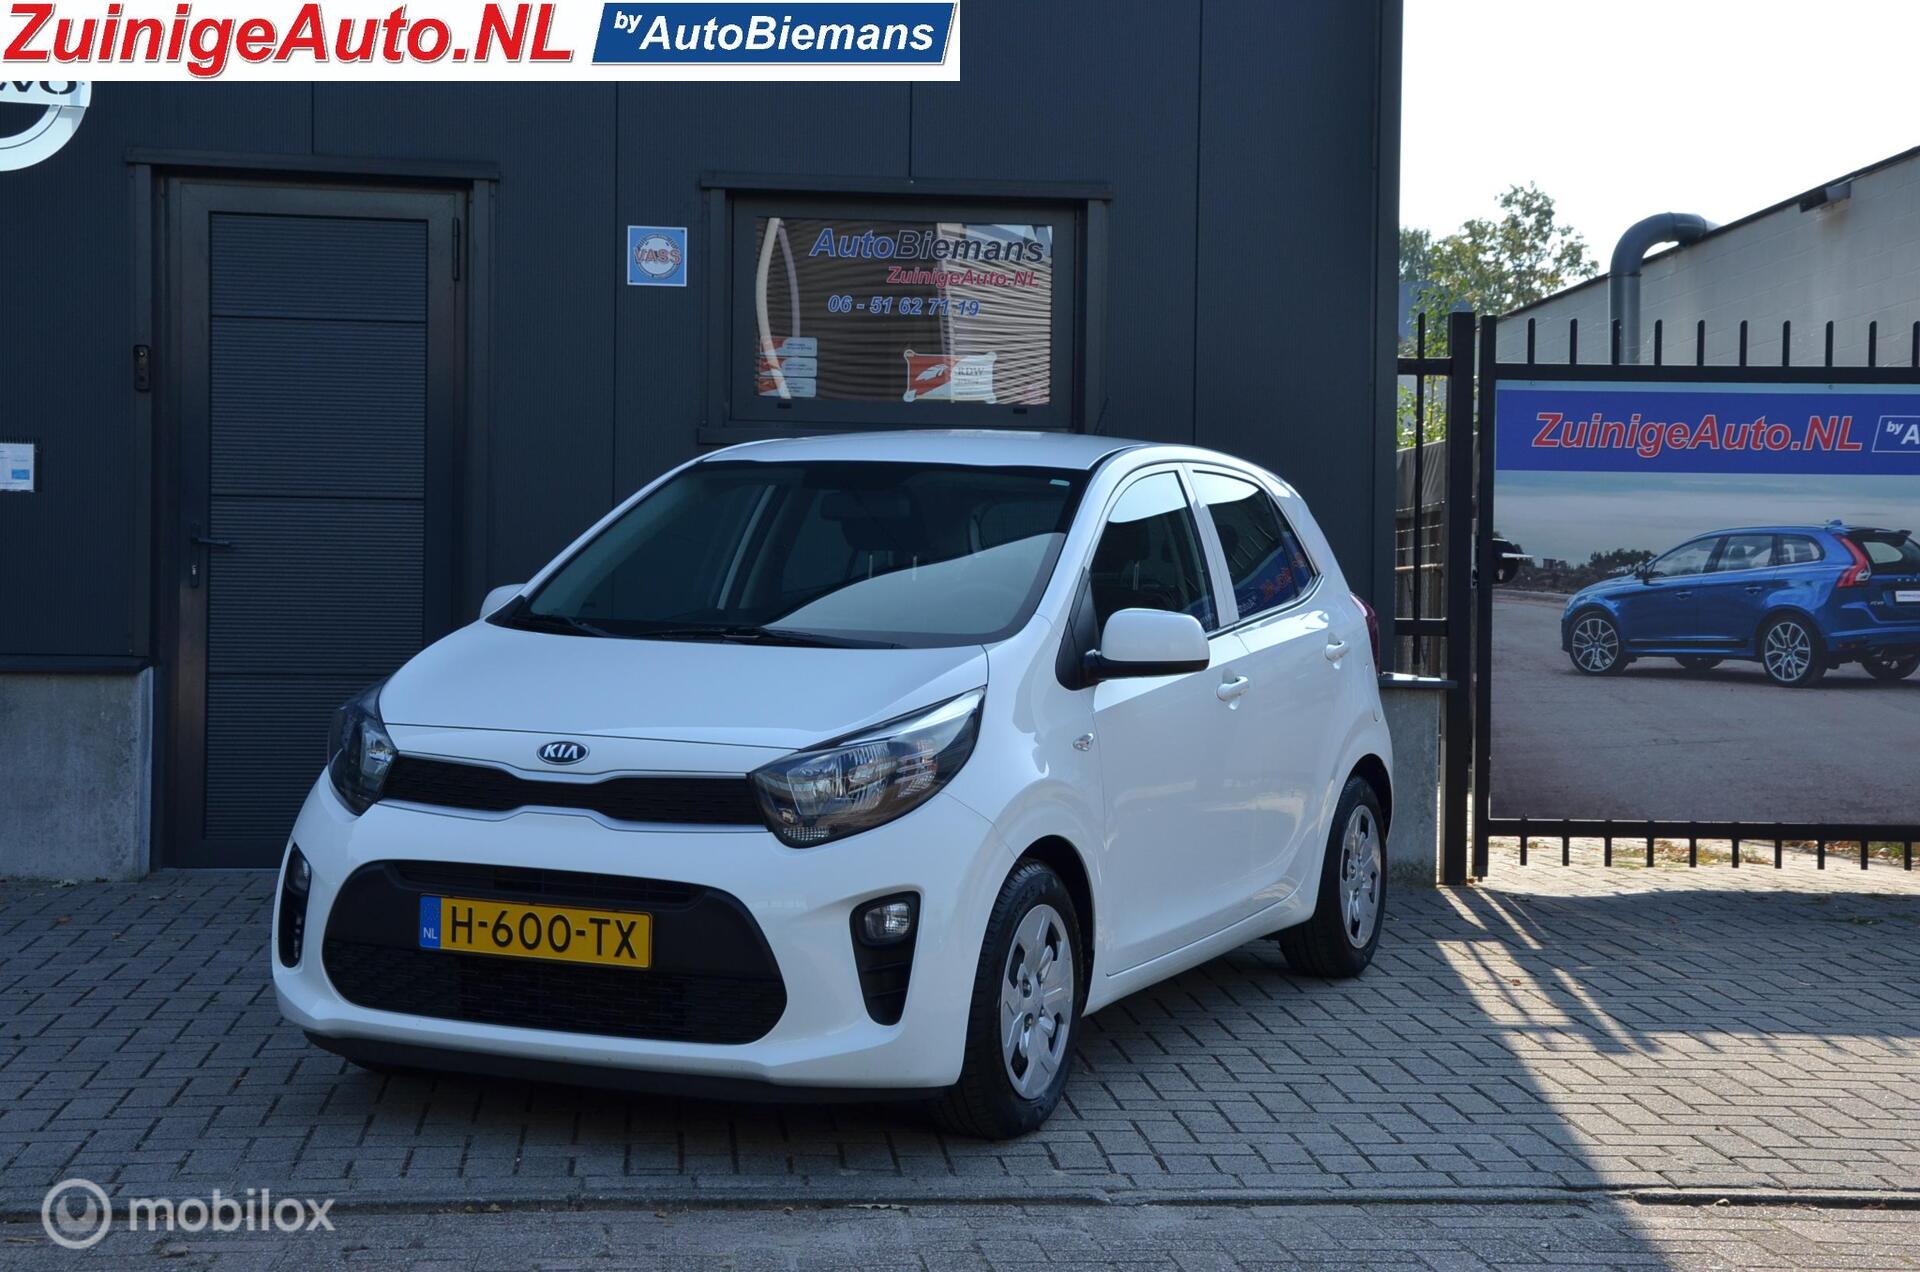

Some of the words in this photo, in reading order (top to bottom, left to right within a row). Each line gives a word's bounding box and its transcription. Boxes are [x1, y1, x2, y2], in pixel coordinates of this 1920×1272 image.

[808, 228, 1044, 262] AutoBiemans
[886, 265, 1040, 289] ZuinigeAuto.NL
[828, 295, 853, 313] 06
[870, 297, 893, 314] 51
[899, 297, 923, 315] 62
[928, 299, 950, 316] 71
[957, 300, 981, 316] 19
[1531, 412, 1863, 458] ZuinigeAuto.NL
[1886, 421, 1904, 435] by
[543, 744, 578, 759] KIA
[423, 927, 438, 940] NL
[451, 906, 637, 960] H-600-TX
